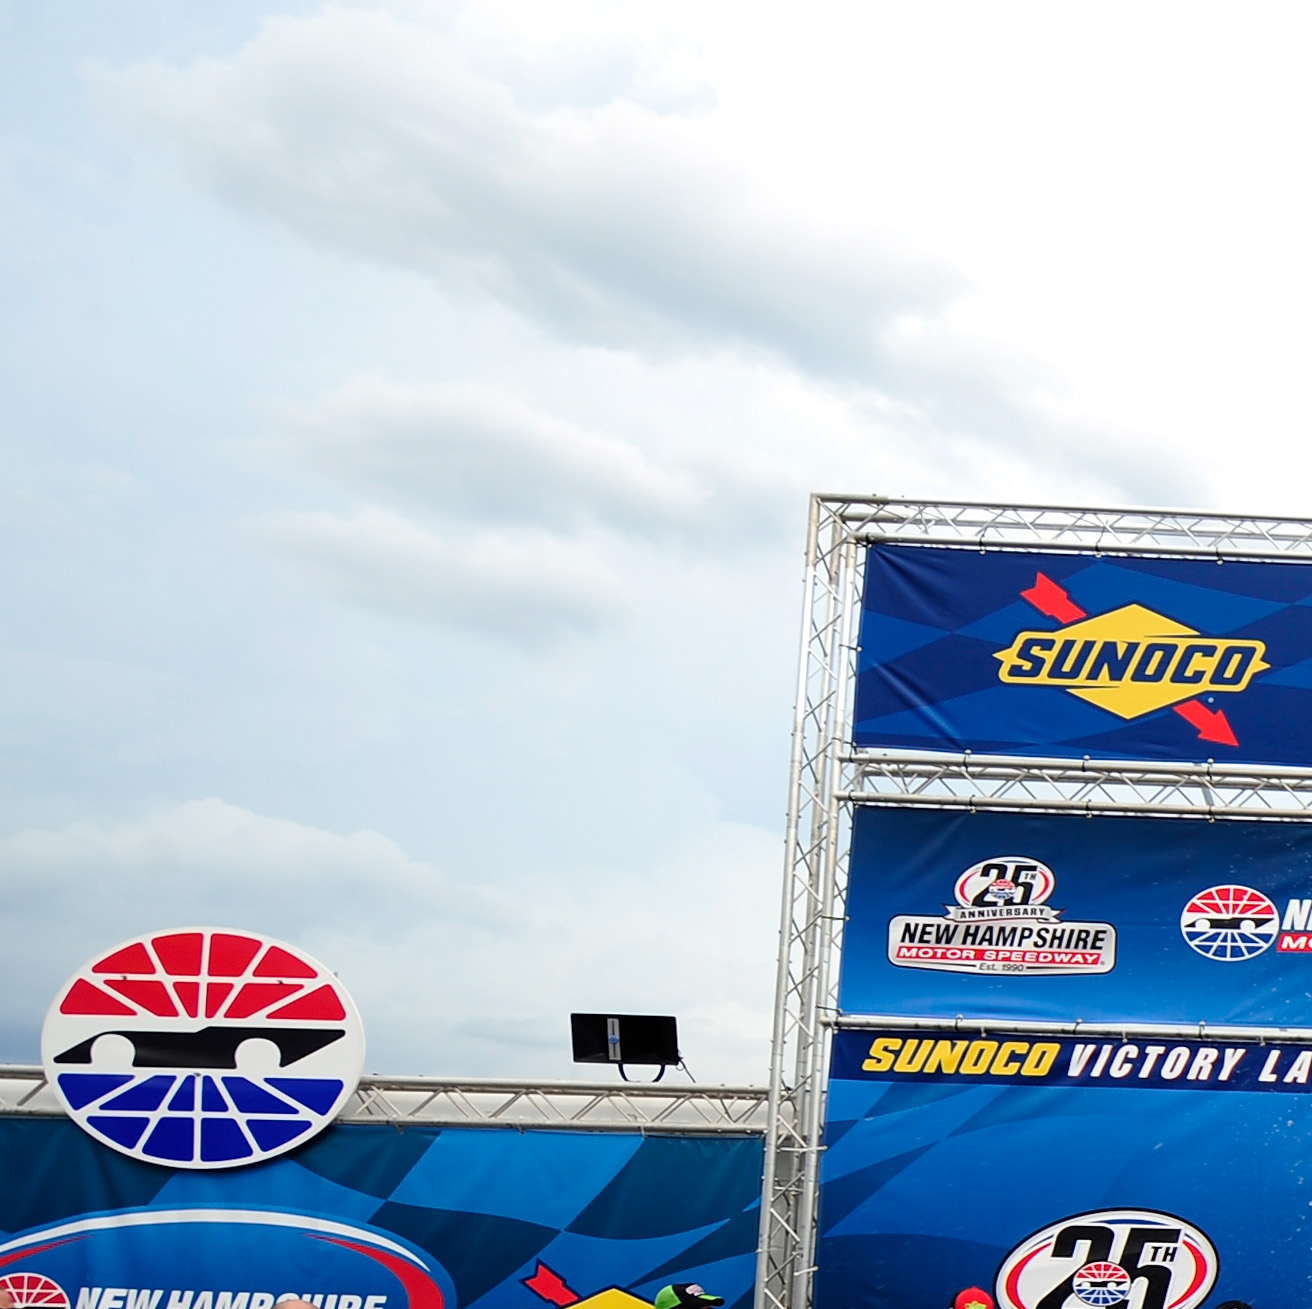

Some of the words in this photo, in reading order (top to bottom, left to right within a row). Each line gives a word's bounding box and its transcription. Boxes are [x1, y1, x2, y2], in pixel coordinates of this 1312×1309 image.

[1008, 637, 1263, 687] SUNOCO
[960, 907, 1046, 919] ANNIVERSARY
[901, 923, 960, 944] NEW
[961, 924, 1107, 950] HAMPSHIRE
[899, 947, 976, 959] MOTOR
[983, 950, 1099, 964] SPEEDWAY
[979, 963, 997, 971] Est.
[1001, 963, 1024, 972] 1990
[862, 1038, 1061, 1077] SUNOCO
[1068, 1043, 1246, 1081] VICTORY
